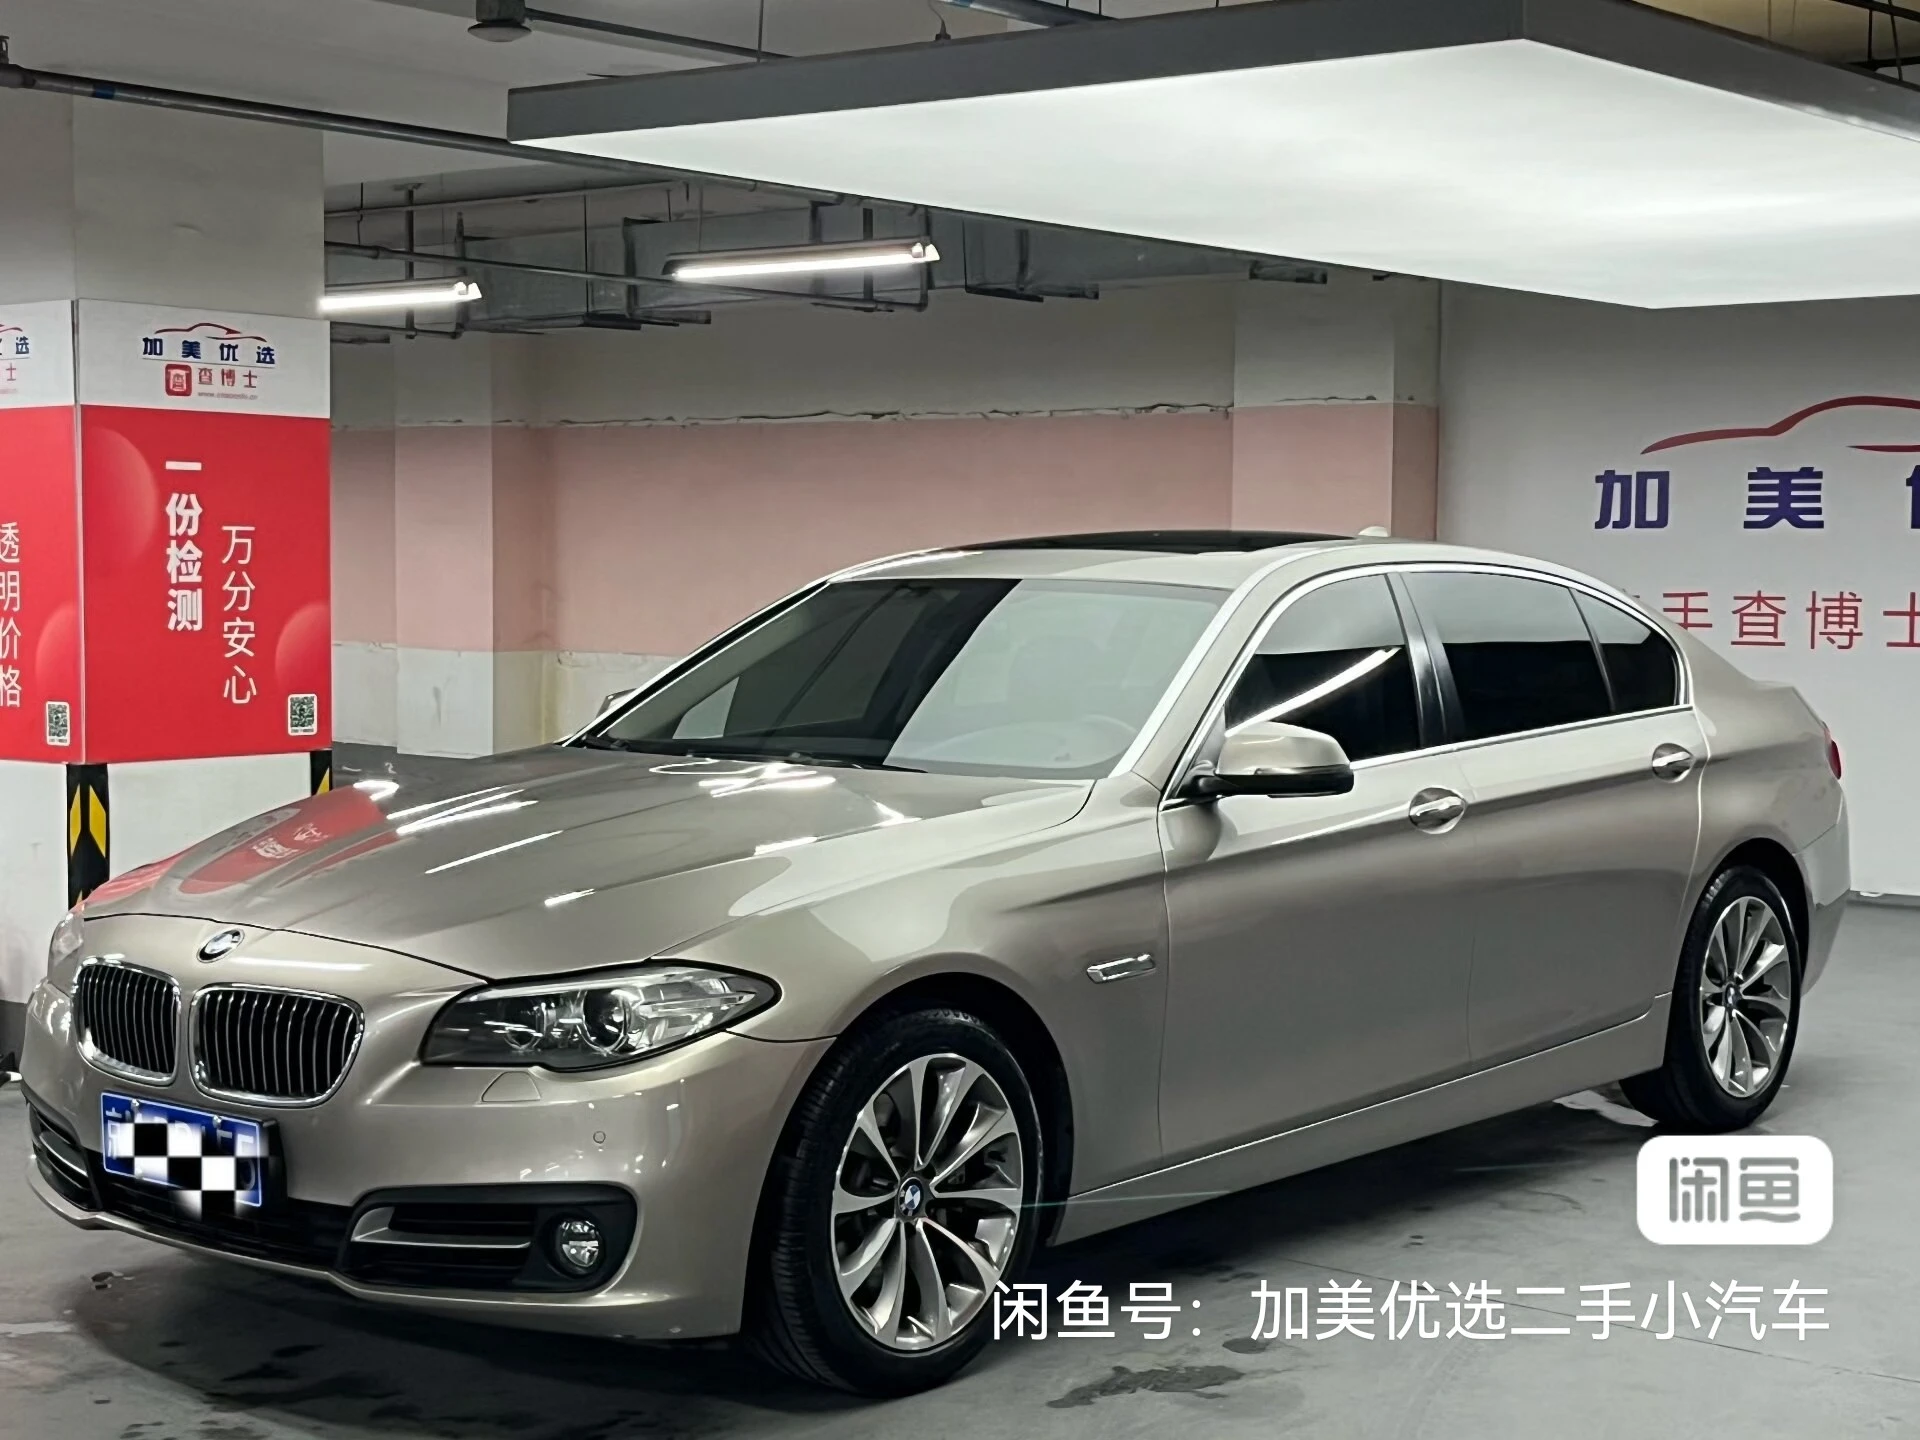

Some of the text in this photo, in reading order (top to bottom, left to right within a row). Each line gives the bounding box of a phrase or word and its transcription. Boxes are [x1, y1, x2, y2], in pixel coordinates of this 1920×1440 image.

[142, 337, 275, 364] 加美优选
[198, 367, 258, 388] 查博士
[165, 461, 203, 631] 一份检测
[0, 521, 22, 707] 透明价格
[222, 525, 257, 704] 万分安心
[1622, 590, 1920, 650] 手查博士
